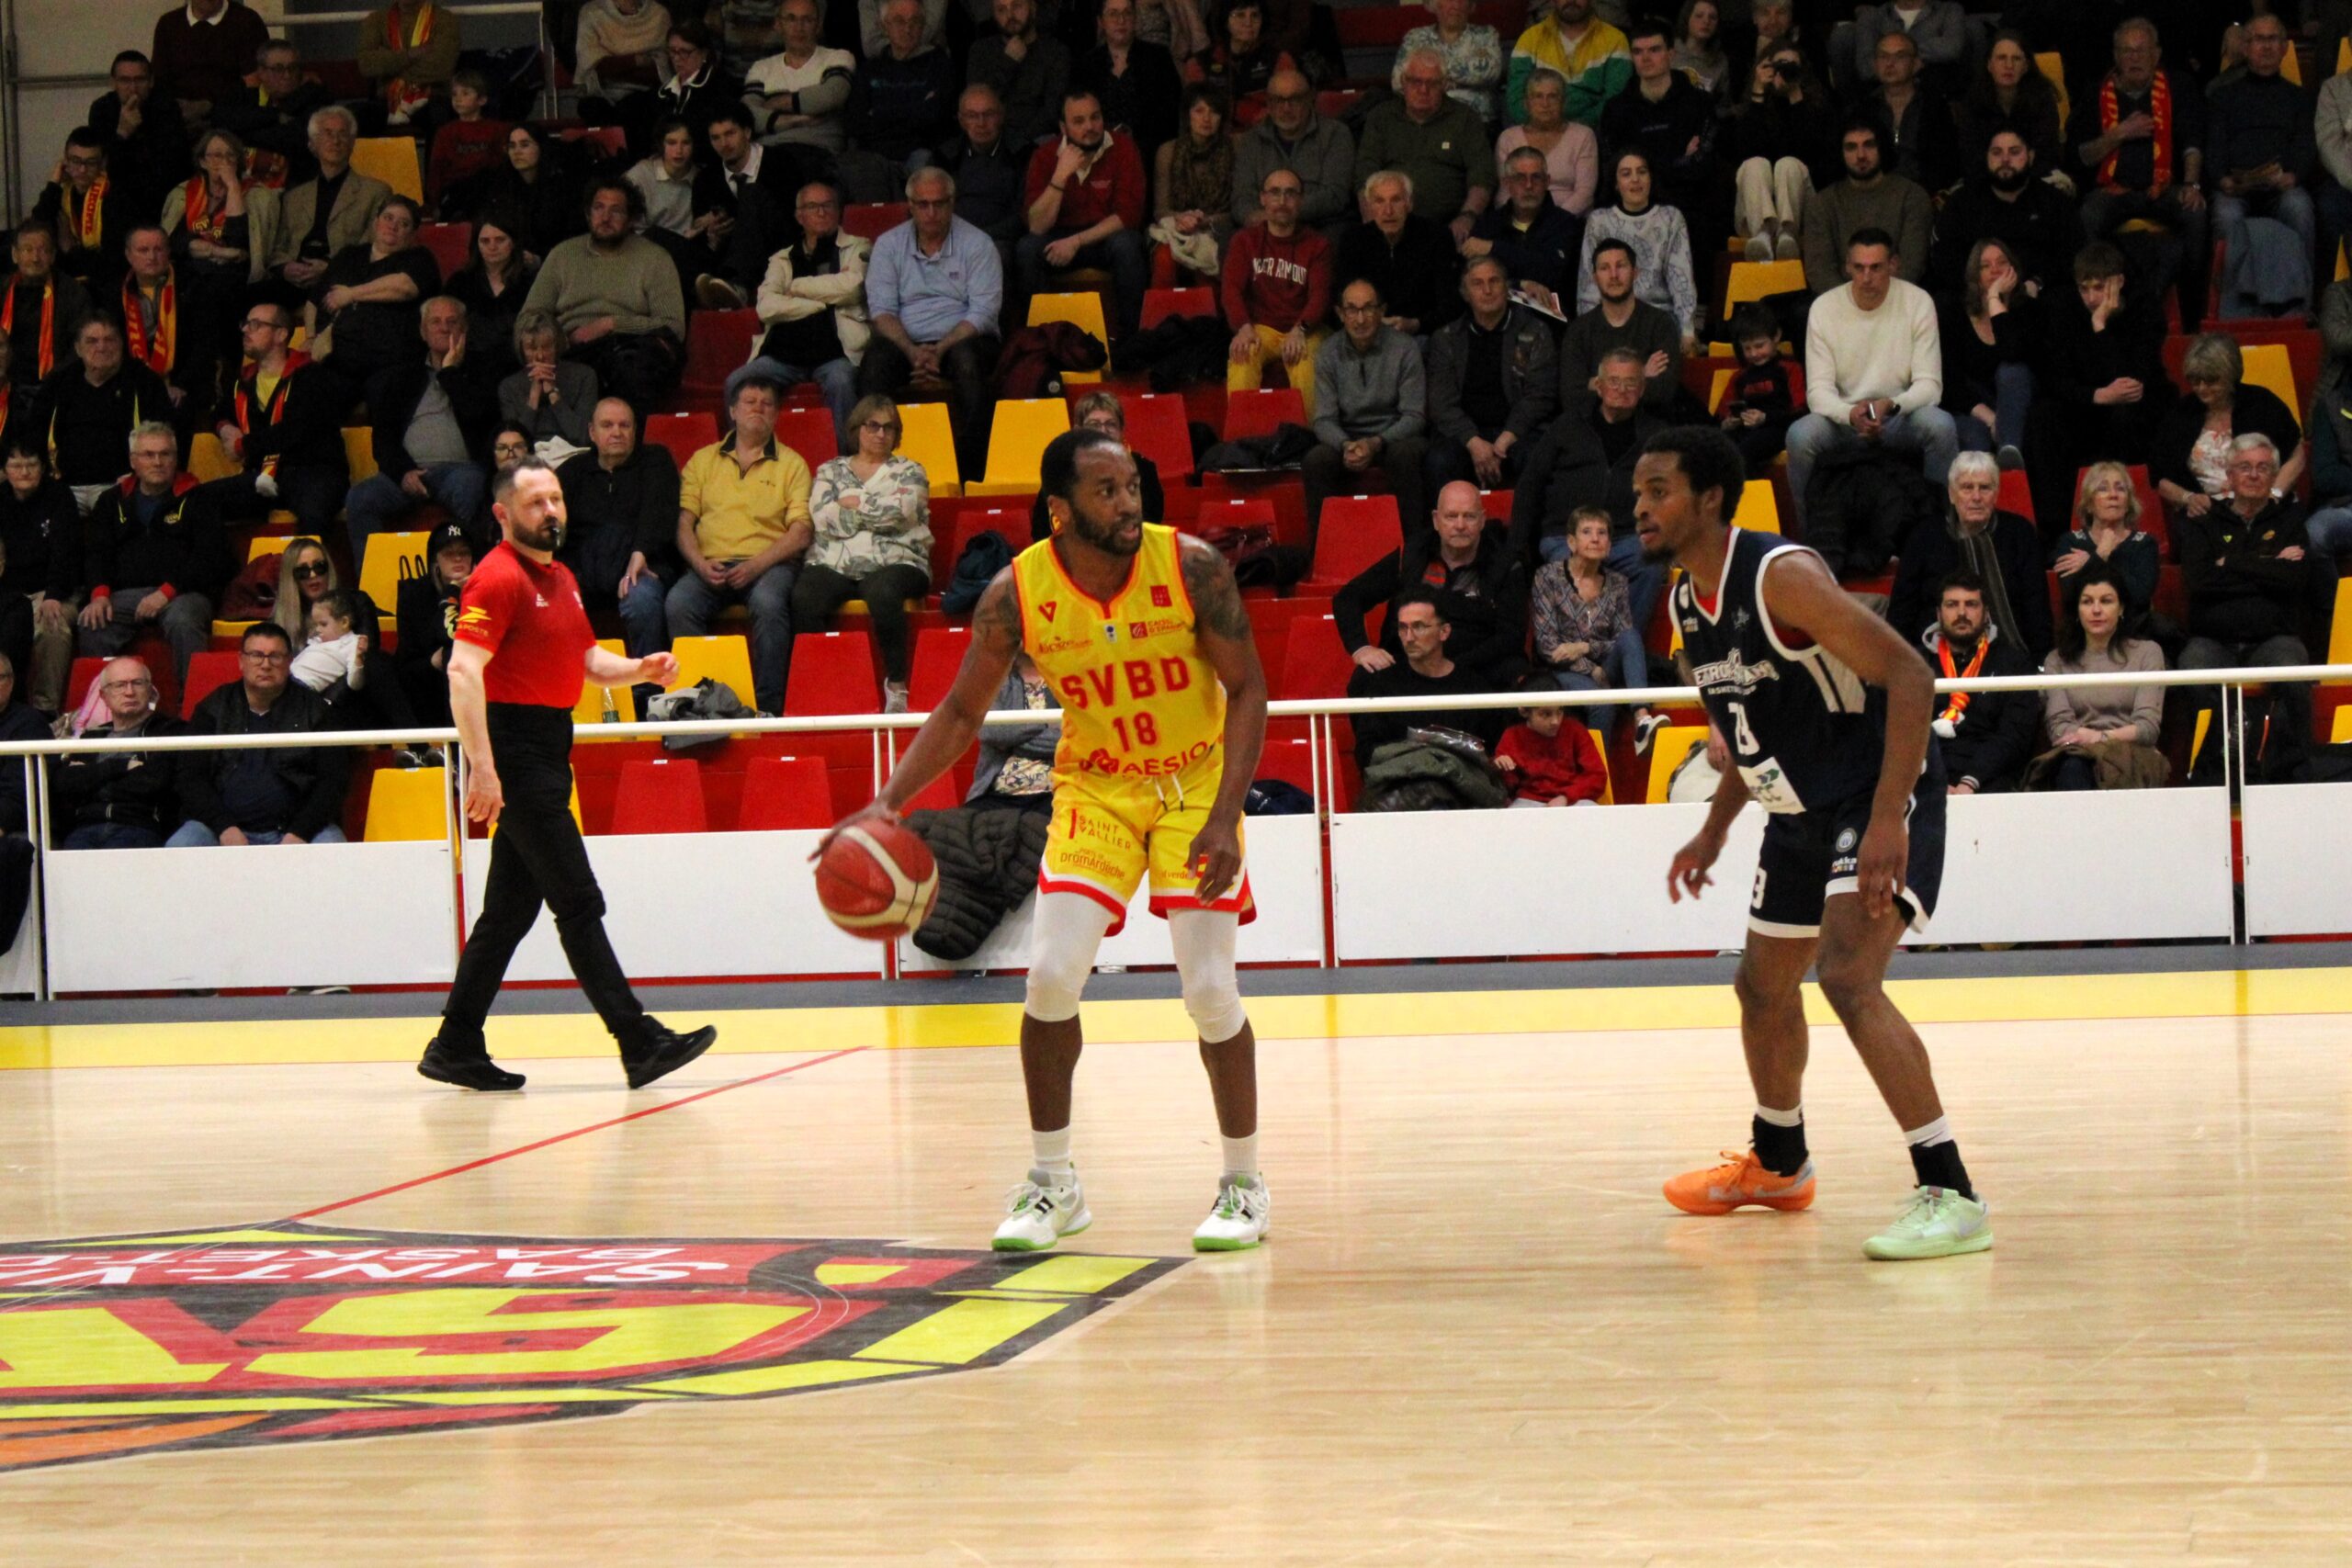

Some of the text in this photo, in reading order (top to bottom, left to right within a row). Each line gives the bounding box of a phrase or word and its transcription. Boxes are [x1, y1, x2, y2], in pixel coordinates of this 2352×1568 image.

[1060, 656, 1191, 710] SVBD
[1113, 712, 1158, 752] 18
[1079, 815, 1119, 835] SAINT
[1079, 823, 1132, 852] VALLIER
